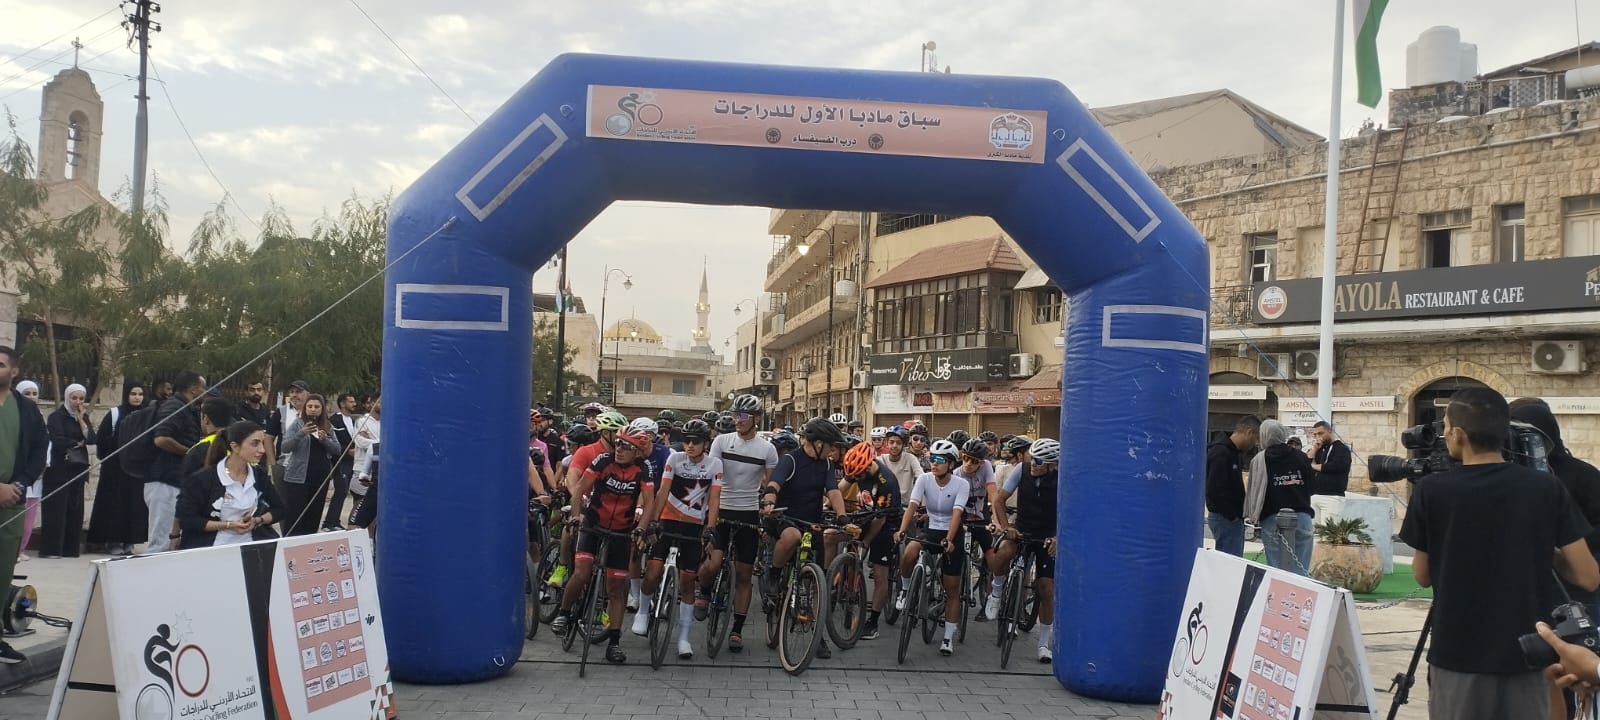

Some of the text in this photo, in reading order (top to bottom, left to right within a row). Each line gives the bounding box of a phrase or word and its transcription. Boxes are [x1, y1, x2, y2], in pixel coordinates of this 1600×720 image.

[714, 99, 941, 130] سباق مادبا الأول للدراجات
[792, 133, 857, 147] درب الفسيفساء
[1333, 280, 1525, 313] AYOLA RESTAURANT & CAFE
[899, 354, 929, 382] Vibes
[591, 452, 609, 466] BMC
[606, 477, 637, 490] BMC
[180, 685, 256, 717] الاتحاد الأردني للدراجات
[227, 701, 258, 716] Federation
